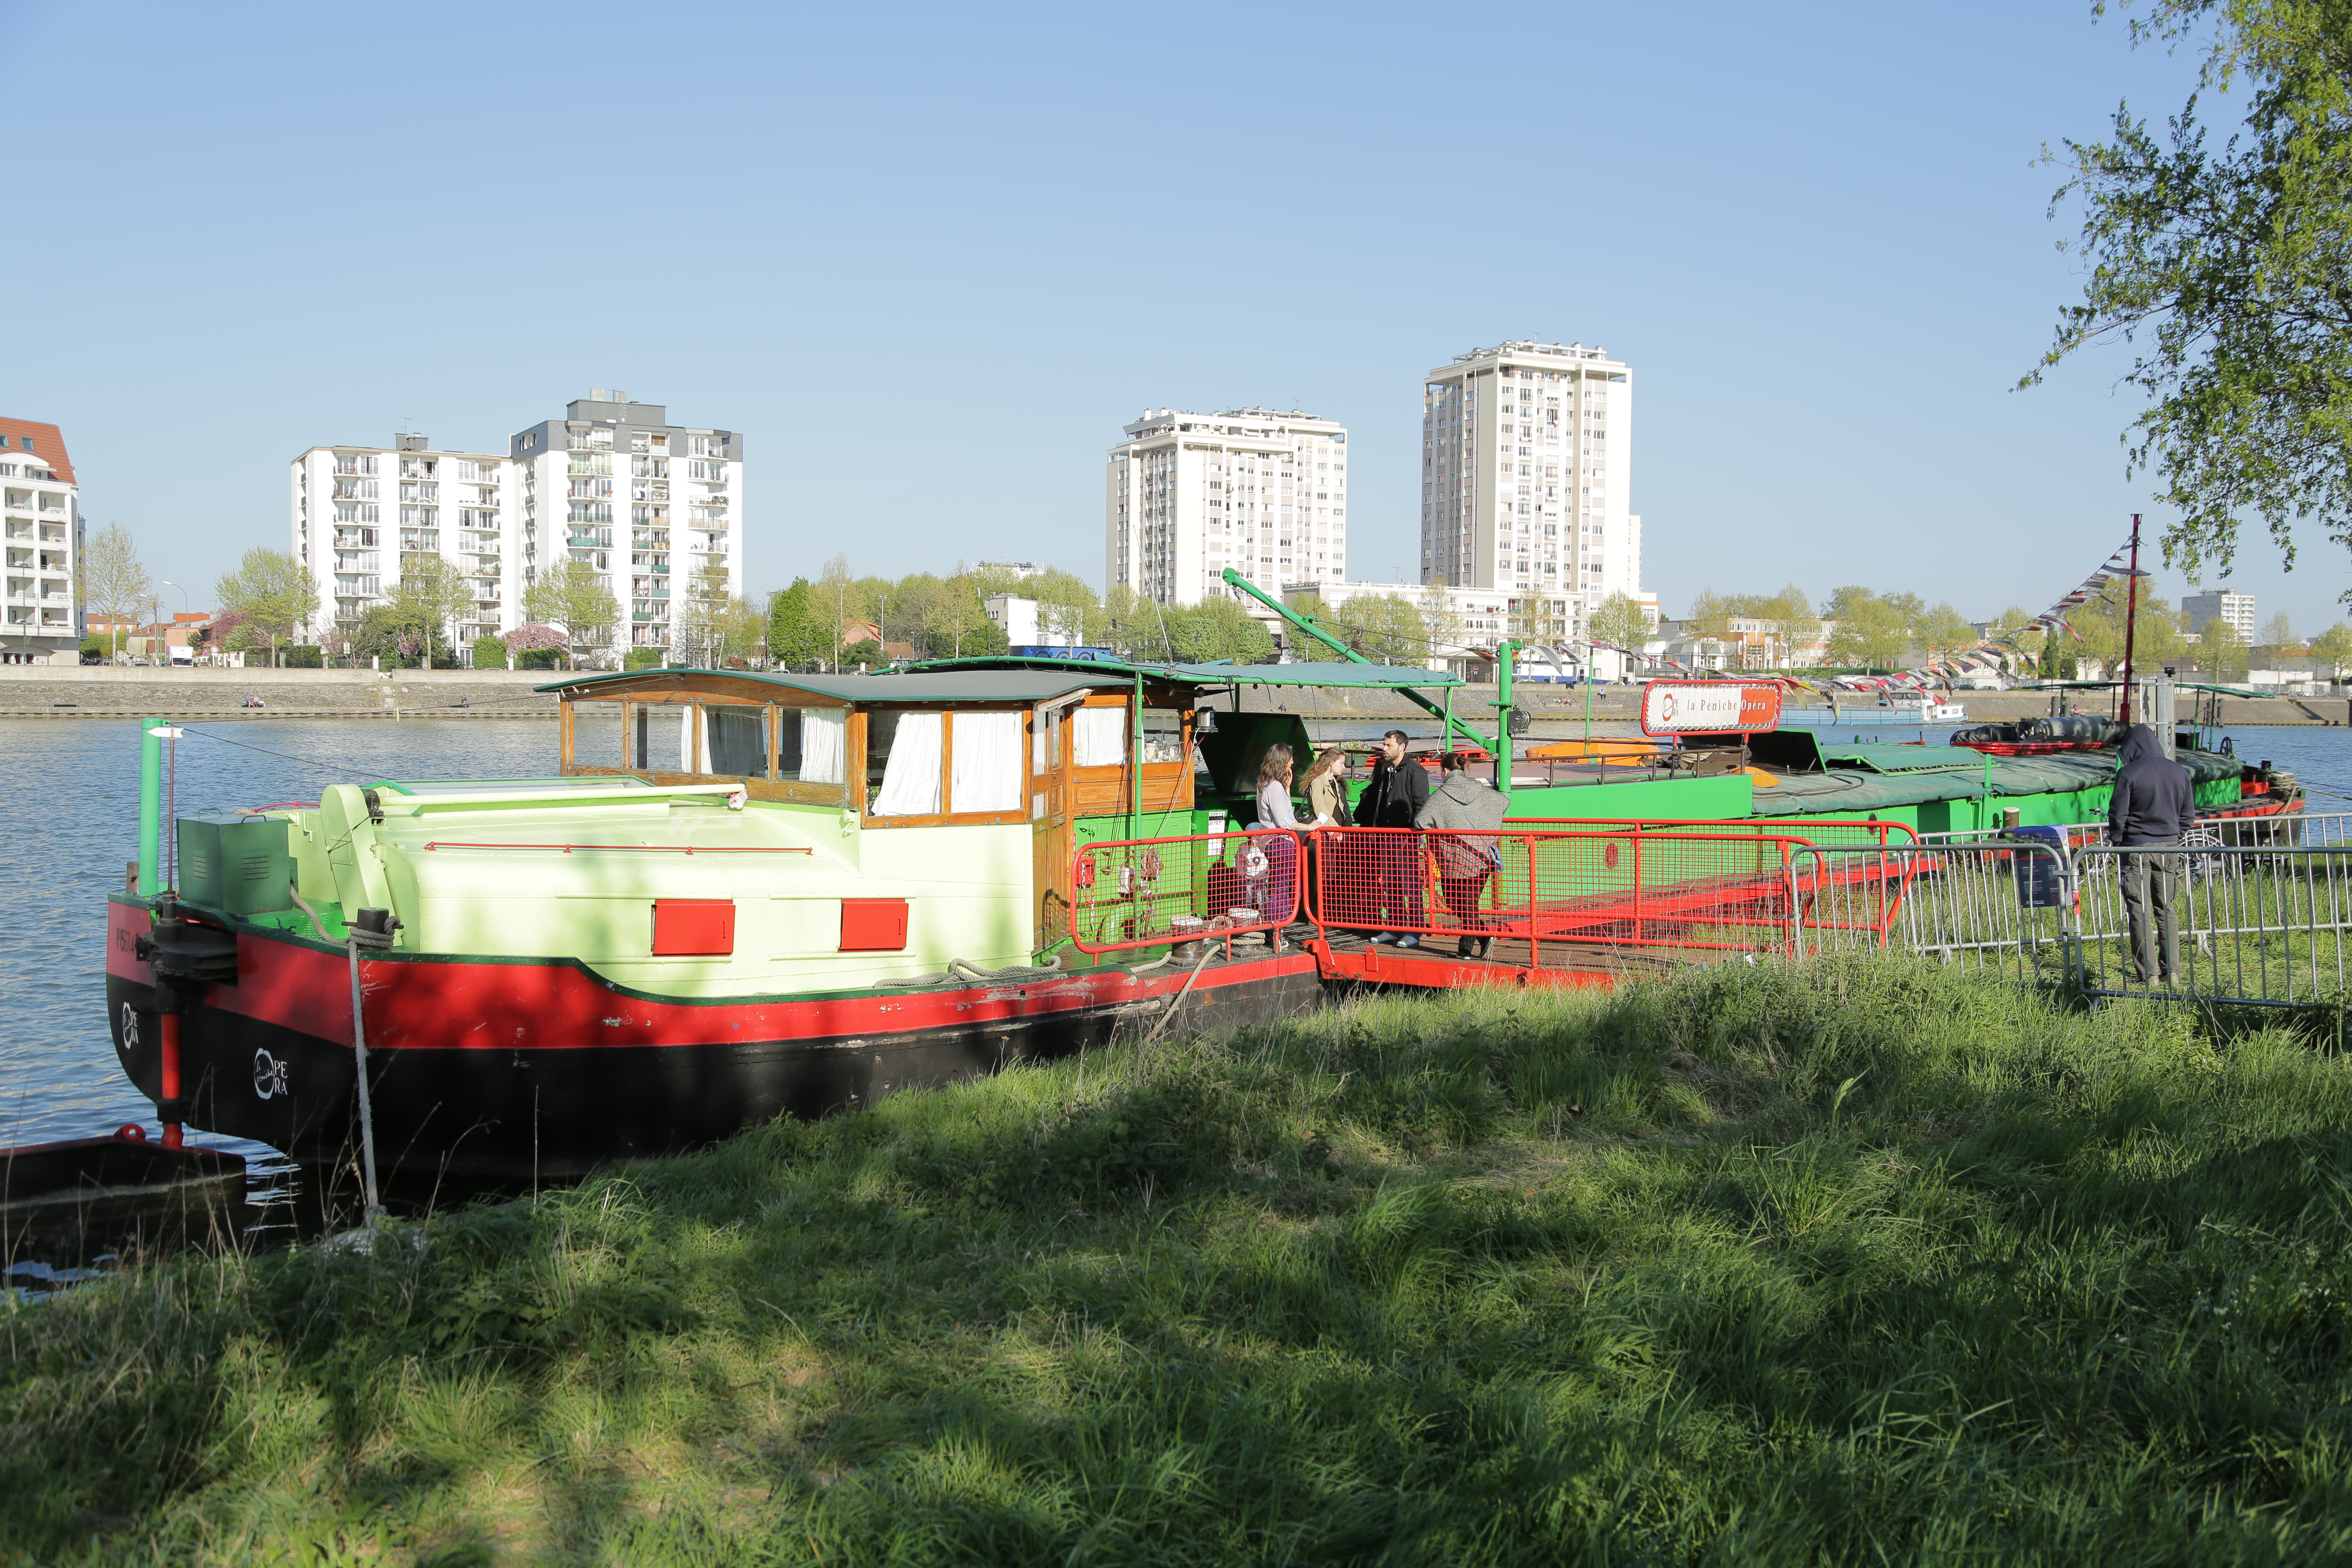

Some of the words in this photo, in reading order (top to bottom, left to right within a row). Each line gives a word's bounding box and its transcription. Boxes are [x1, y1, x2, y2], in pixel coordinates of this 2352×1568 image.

[1687, 699, 1695, 710] la
[1700, 699, 1737, 710] Péniche
[1741, 699, 1766, 713] Opéra
